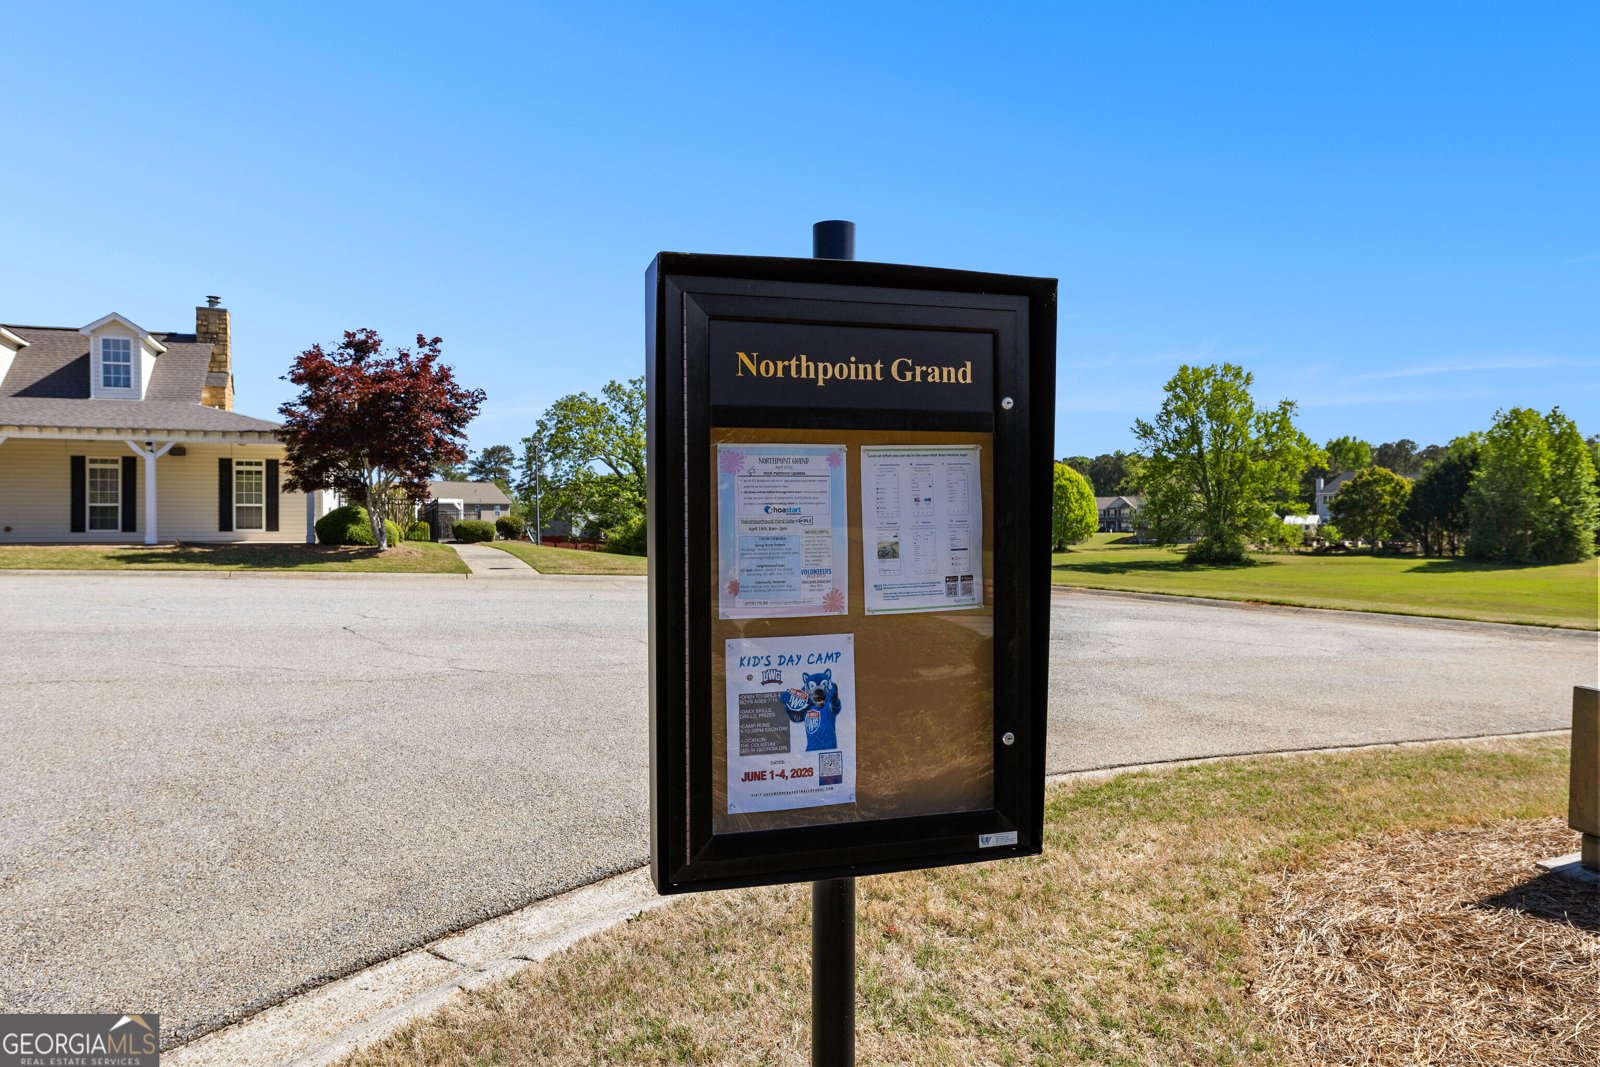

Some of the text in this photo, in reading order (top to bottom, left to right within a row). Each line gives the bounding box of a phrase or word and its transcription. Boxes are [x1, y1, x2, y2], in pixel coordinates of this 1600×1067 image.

[736, 351, 973, 386] Northpoint Grand
[758, 457, 809, 465] NORTHPOINT GRAND
[739, 651, 841, 668] KID'S DAY CAMP
[761, 669, 782, 681] UWG
[741, 767, 814, 782] JUNE 1-4, 2026
